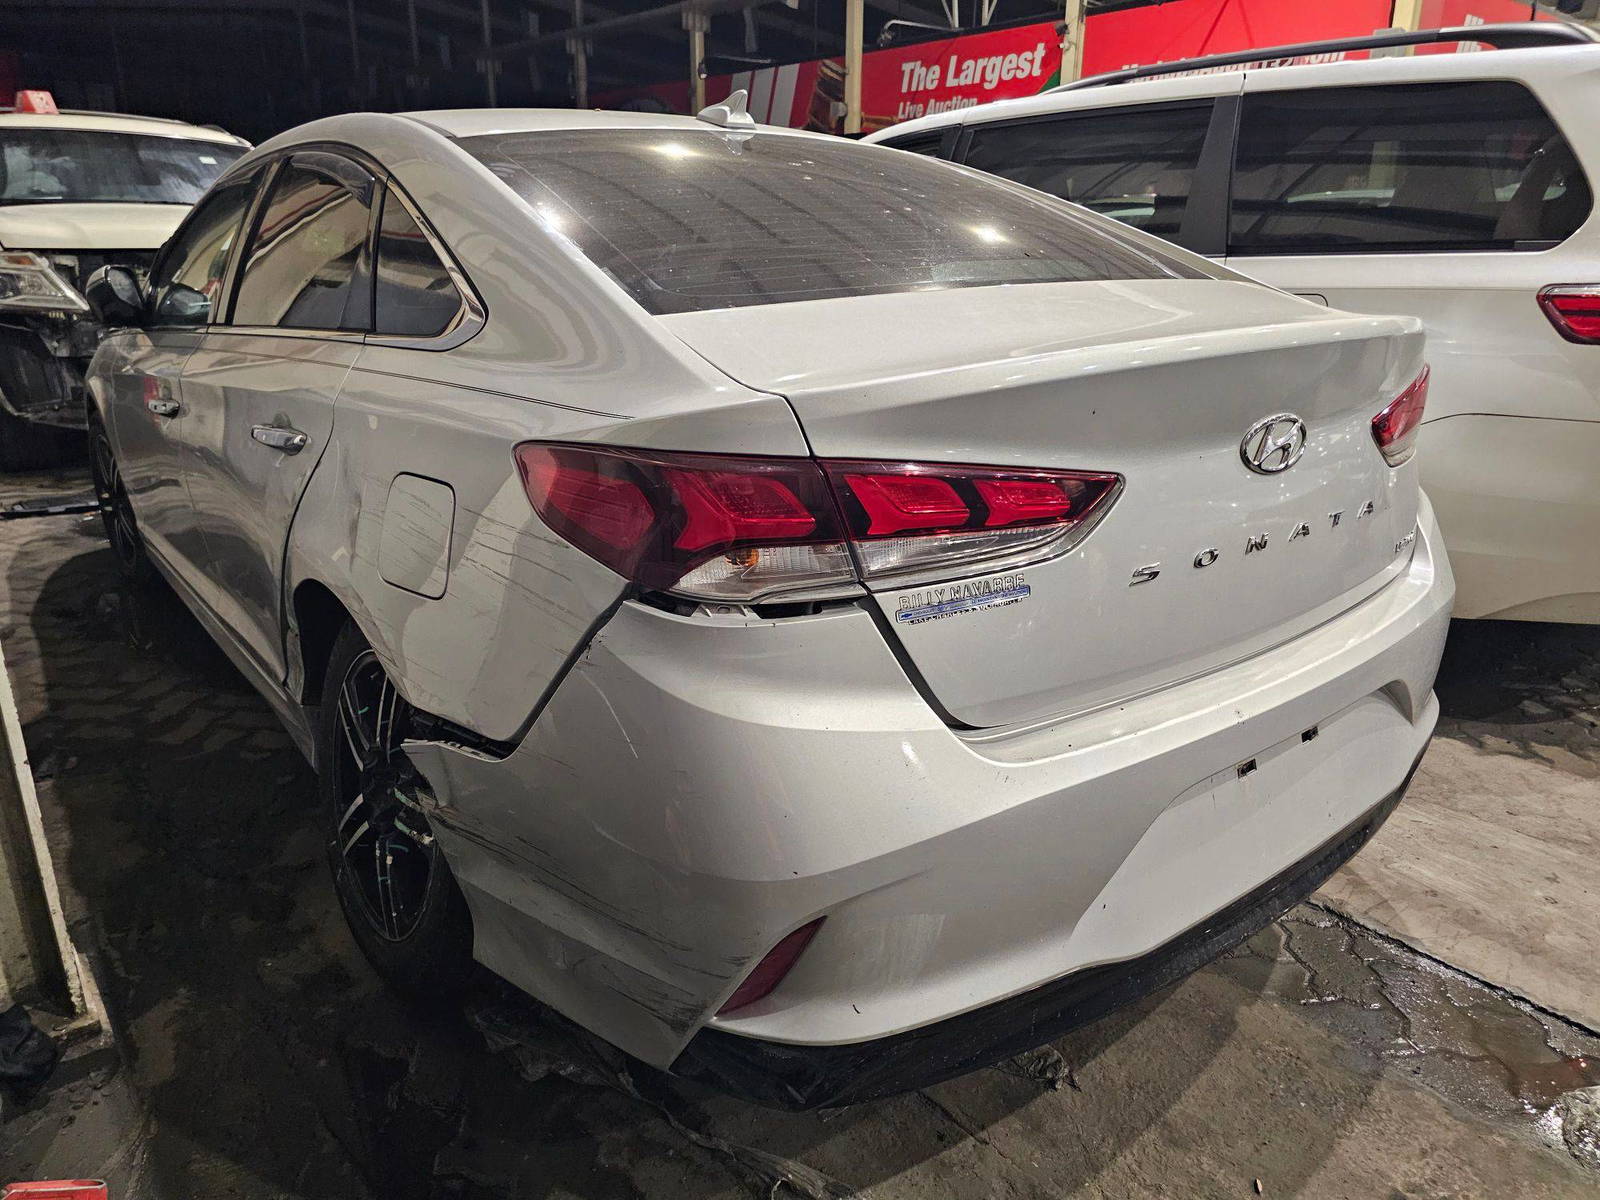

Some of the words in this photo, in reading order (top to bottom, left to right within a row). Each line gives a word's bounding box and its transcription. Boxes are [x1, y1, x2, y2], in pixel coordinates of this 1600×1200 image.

[901, 60, 940, 93] The
[946, 42, 1046, 90] Largest
[898, 101, 924, 119] Live
[926, 95, 978, 115] Auction
[1128, 500, 1375, 587] SONATA
[898, 588, 946, 611] BILLY
